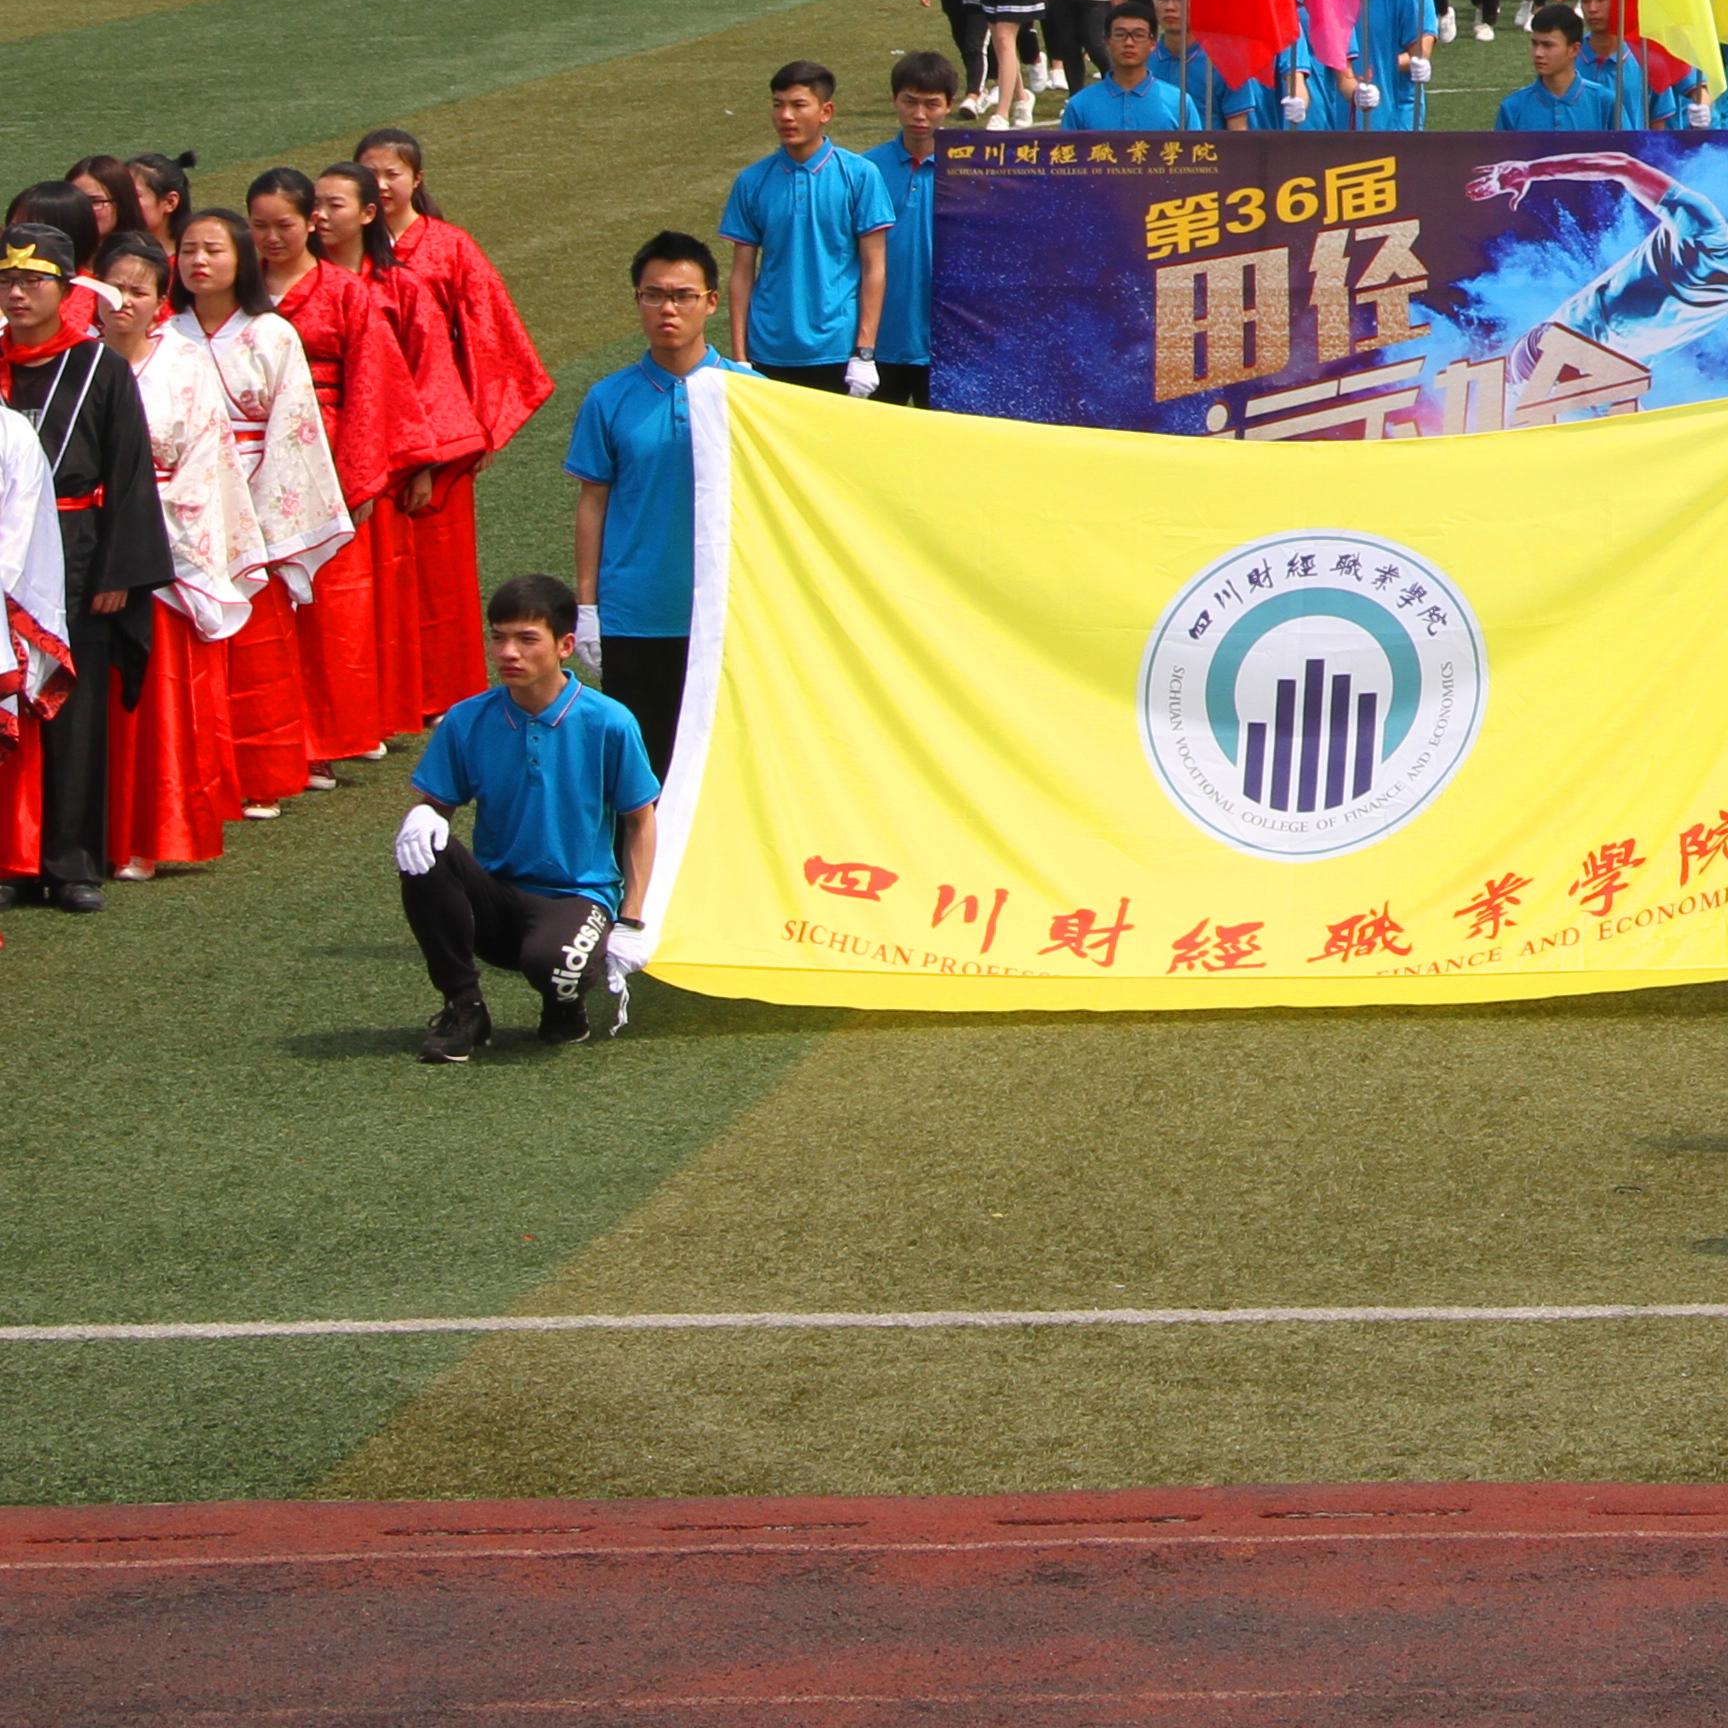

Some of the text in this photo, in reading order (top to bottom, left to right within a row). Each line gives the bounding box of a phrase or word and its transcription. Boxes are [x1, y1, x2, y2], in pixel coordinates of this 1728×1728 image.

[985, 168, 1046, 176] PROFESSIONAL
[1050, 167, 1088, 175] COLLEGE
[1091, 167, 1103, 175] OF
[1107, 167, 1143, 175] FINANCE
[1148, 167, 1166, 175] AND
[1169, 167, 1218, 175] ECONOMICS
[1144, 156, 1398, 261] 第36届
[1155, 218, 1432, 403] 田径
[1168, 660, 1455, 833] SICHUAN VOCATIONAL COLLEGE OF FINANCE AND ECONOMICS
[780, 918, 915, 967] SICHUAN
[1519, 926, 1581, 958] AND
